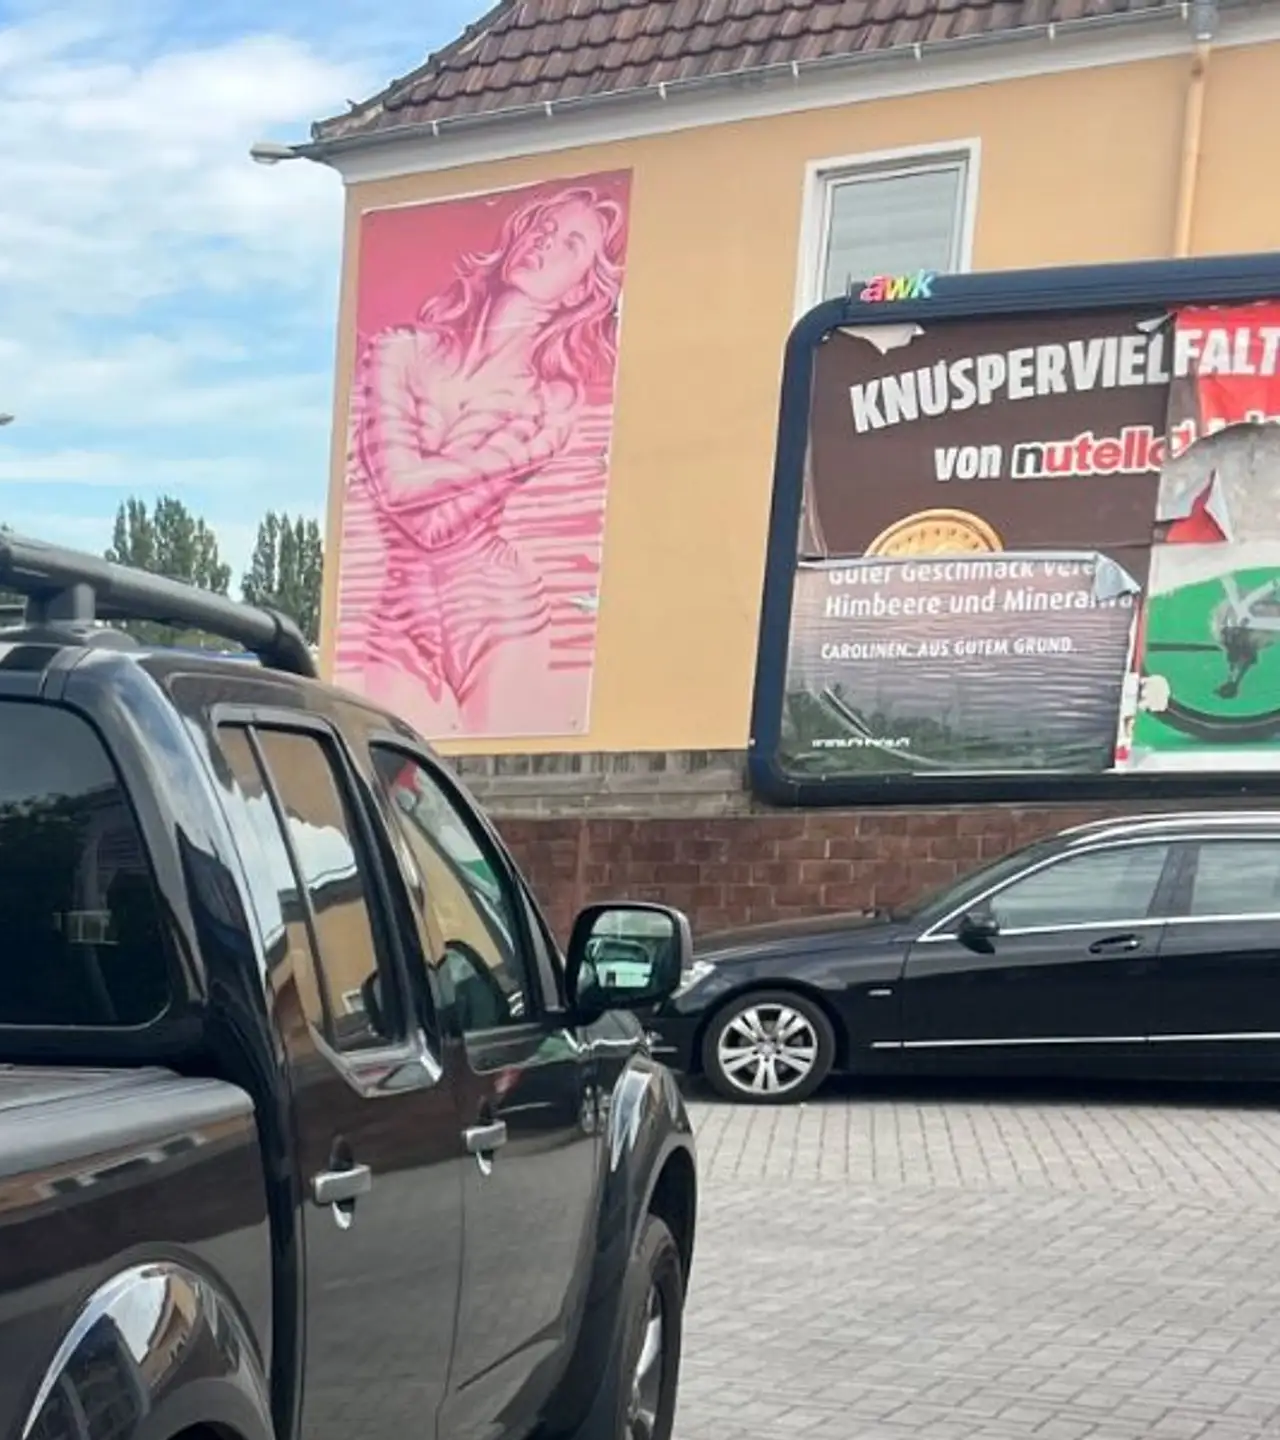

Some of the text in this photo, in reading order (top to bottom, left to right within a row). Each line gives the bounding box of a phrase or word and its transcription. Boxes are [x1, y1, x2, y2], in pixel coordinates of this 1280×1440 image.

[860, 269, 936, 303] awk
[933, 445, 1002, 482] von
[901, 558, 1035, 582] Geschmack
[825, 591, 942, 618] Himbeere
[949, 589, 996, 615] und
[916, 639, 949, 657] AUS
